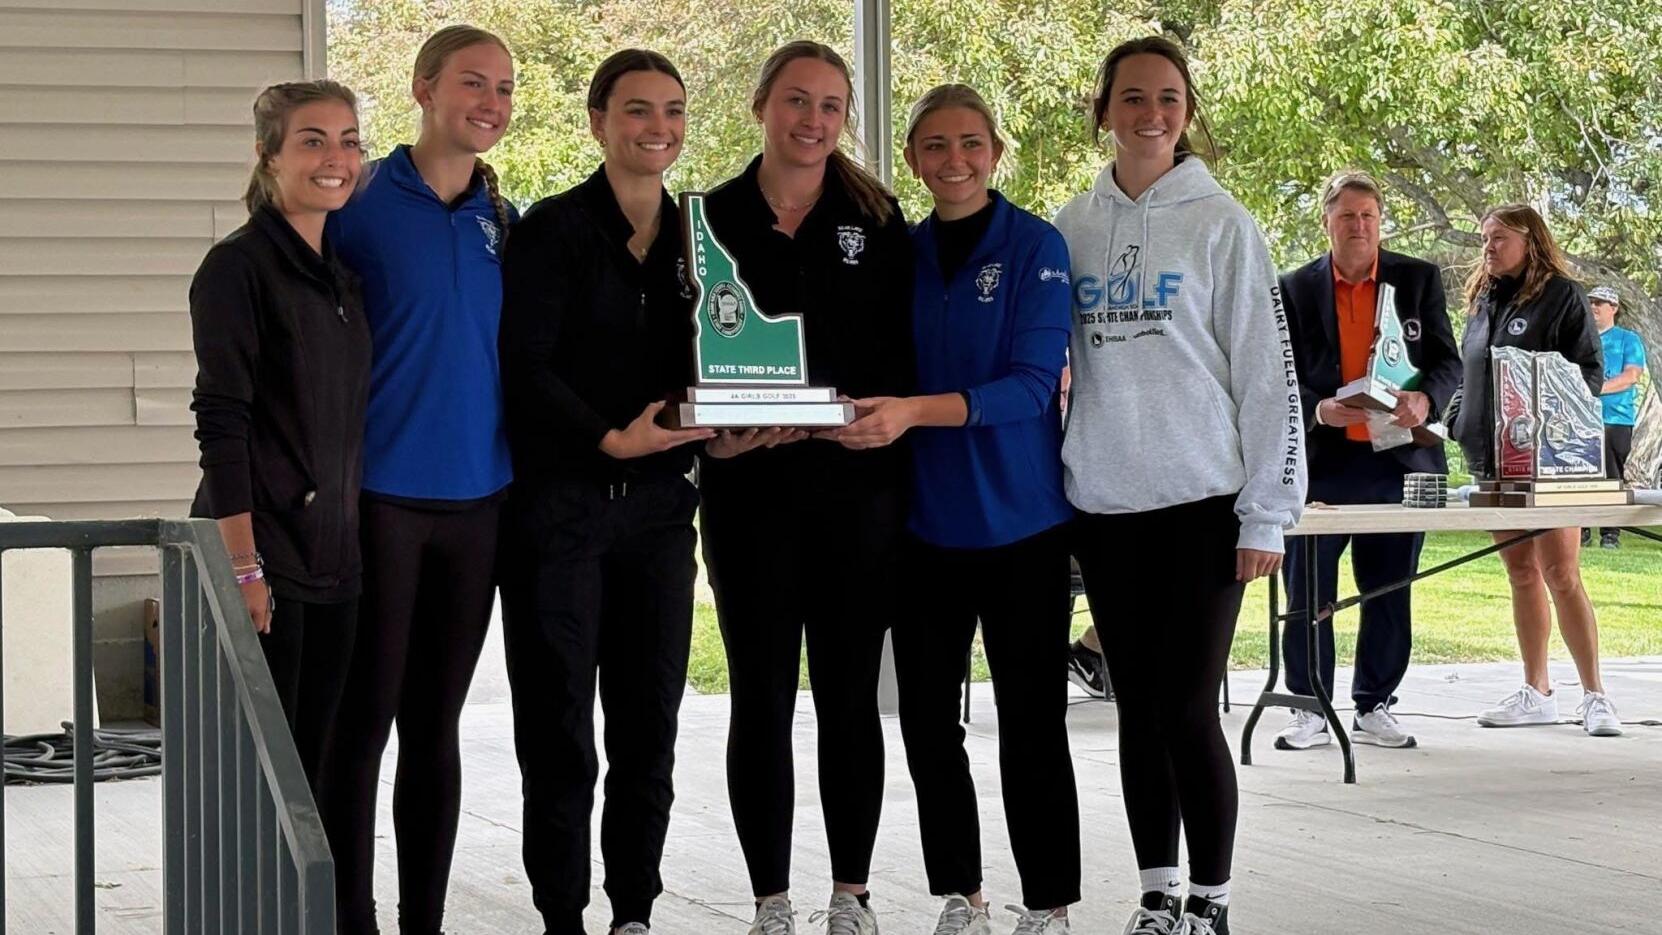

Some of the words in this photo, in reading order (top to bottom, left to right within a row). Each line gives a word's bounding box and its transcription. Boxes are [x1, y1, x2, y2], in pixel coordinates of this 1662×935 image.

[696, 219, 708, 276] IDAHO
[1074, 271, 1184, 311] GOLF
[1270, 286, 1288, 332] DAIRY
[1080, 312, 1096, 325] 2025
[708, 364, 737, 374] STATE
[738, 365, 766, 375] THIRD
[766, 366, 797, 375] PLACE
[1281, 340, 1297, 388] FUELS
[741, 392, 761, 400] GIRLS
[1282, 394, 1299, 486] GREATNESS
